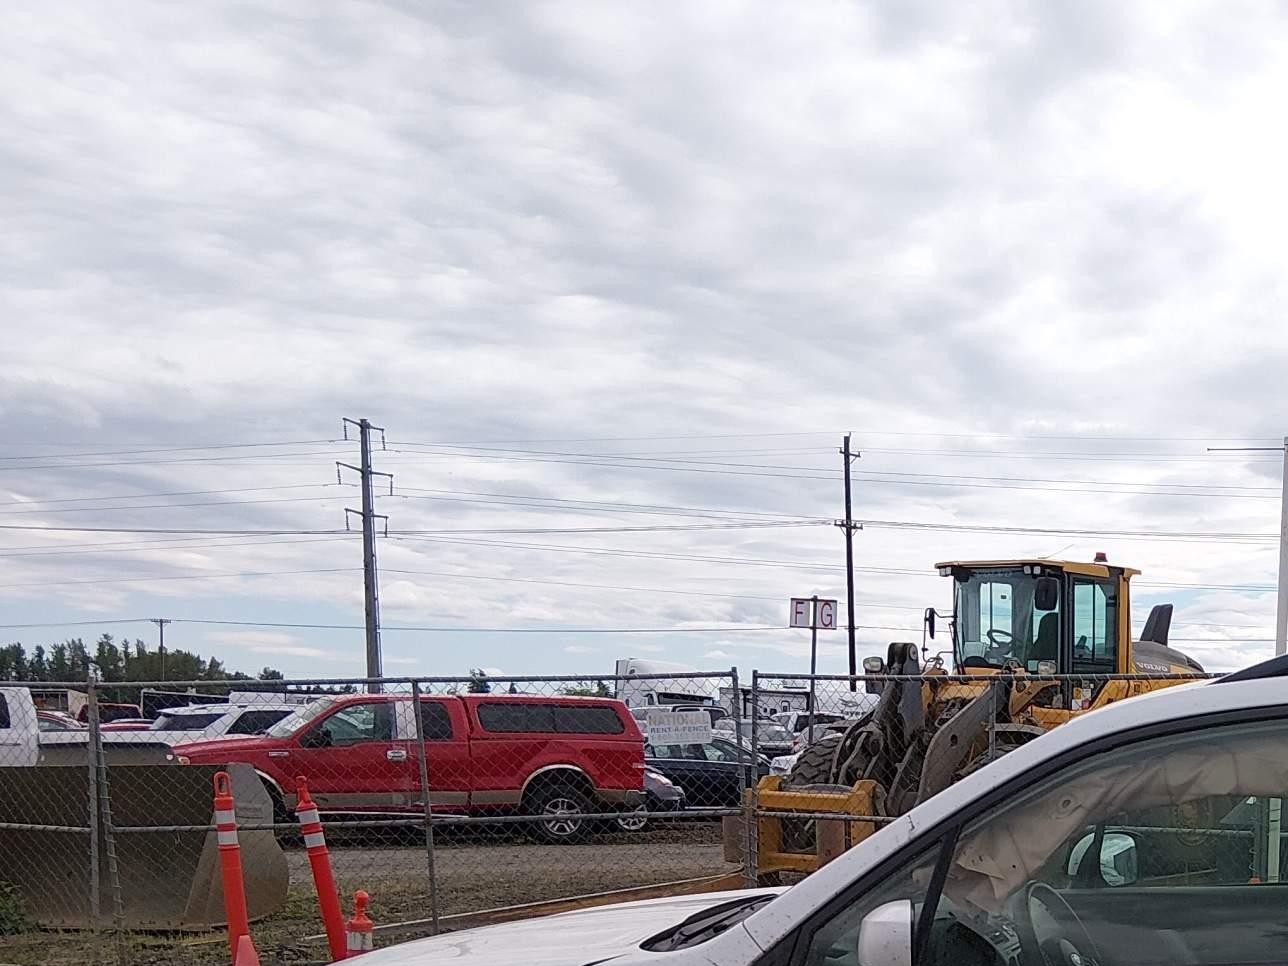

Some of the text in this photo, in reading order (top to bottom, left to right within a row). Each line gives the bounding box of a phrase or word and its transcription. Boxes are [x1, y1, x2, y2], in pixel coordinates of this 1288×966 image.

[794, 601, 805, 625] F
[820, 602, 833, 628] G
[1136, 662, 1169, 672] VOLVO
